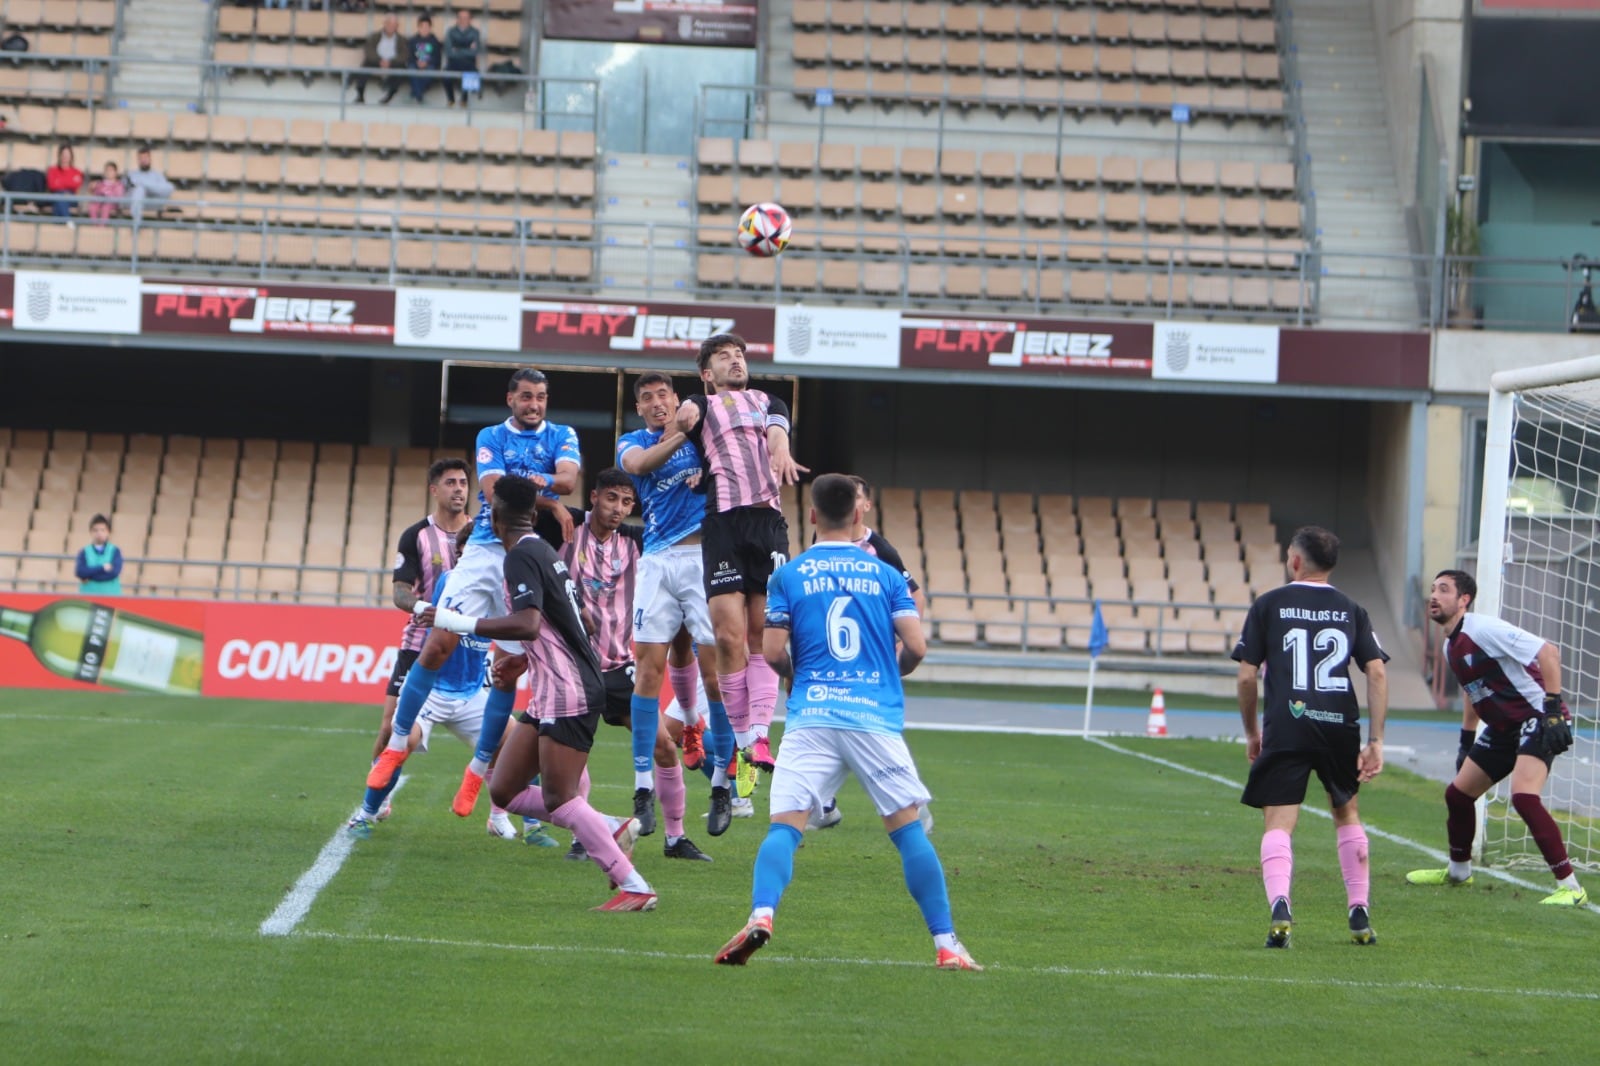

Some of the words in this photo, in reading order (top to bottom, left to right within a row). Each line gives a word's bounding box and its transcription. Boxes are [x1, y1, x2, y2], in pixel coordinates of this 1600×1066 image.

[58, 294, 128, 305] Ayuntamiento
[155, 295, 247, 318] PLAY
[229, 292, 355, 333] JEREZ
[439, 310, 508, 322] Ayuntamiento
[536, 312, 628, 336] PLAY
[818, 328, 888, 340] Ayuntamiento
[914, 328, 1006, 352] PLAY
[988, 326, 1113, 366] JEREZ
[1196, 343, 1266, 355] Ayuntamiento
[803, 576, 834, 595] RAFA
[838, 576, 880, 595] PAREJO
[634, 607, 643, 630] 4
[1279, 607, 1330, 621] BOLLULLOS
[1332, 611, 1349, 623] C.F.
[826, 595, 861, 662] 6
[217, 639, 400, 684] COMPRA
[1282, 627, 1349, 691] 12
[801, 707, 831, 717] XEREZ
